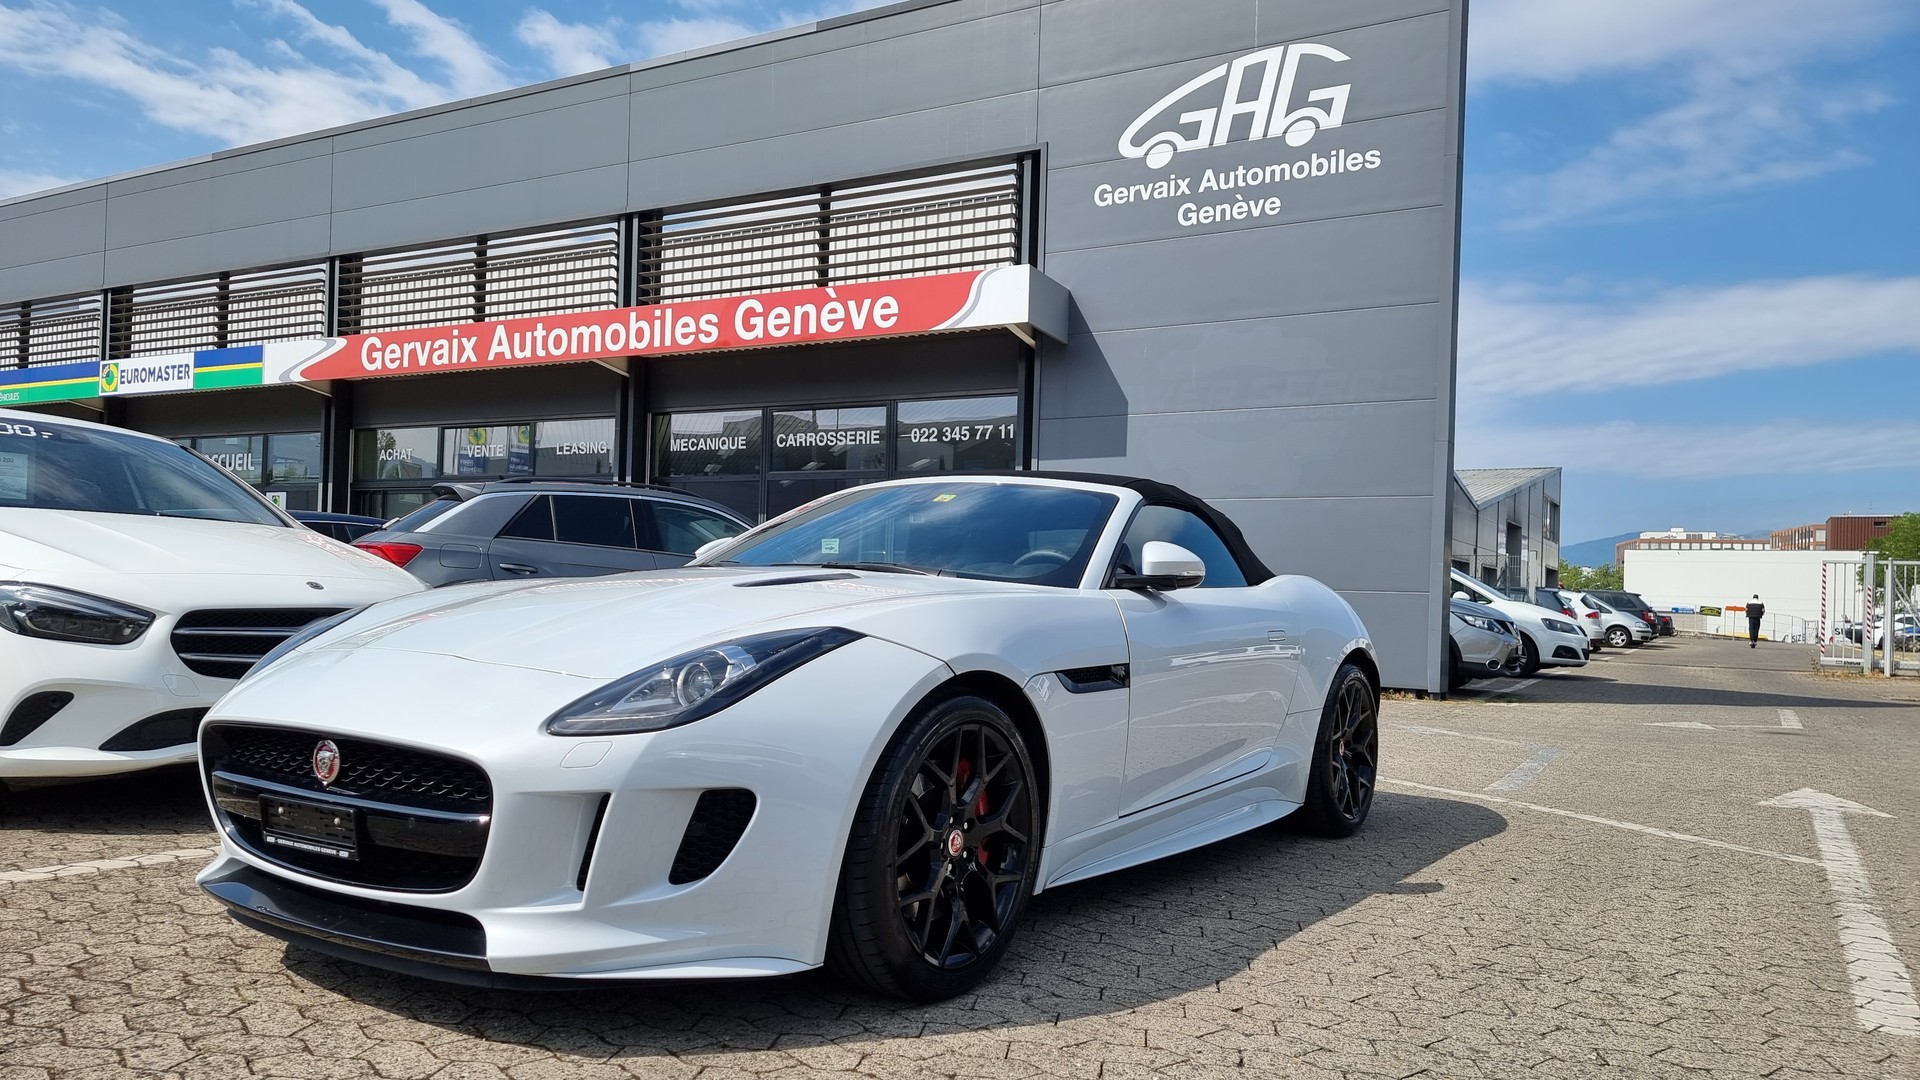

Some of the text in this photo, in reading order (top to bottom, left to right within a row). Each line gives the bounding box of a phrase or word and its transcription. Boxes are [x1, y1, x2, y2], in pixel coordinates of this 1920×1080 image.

[1118, 43, 1351, 159] GAG
[1094, 149, 1381, 207] Gervaix Automobiles
[1177, 194, 1282, 227] Genève
[361, 287, 899, 371] Gervaix Automobiles Genève
[119, 363, 190, 385] EUROMASTER
[776, 430, 881, 448] CARROSSERIE
[910, 423, 1015, 443] 022 345 77 11
[467, 444, 504, 457] VENTE
[556, 441, 608, 455] LEASING
[670, 436, 747, 452] MECANIQUE
[379, 448, 413, 461] ACHAT
